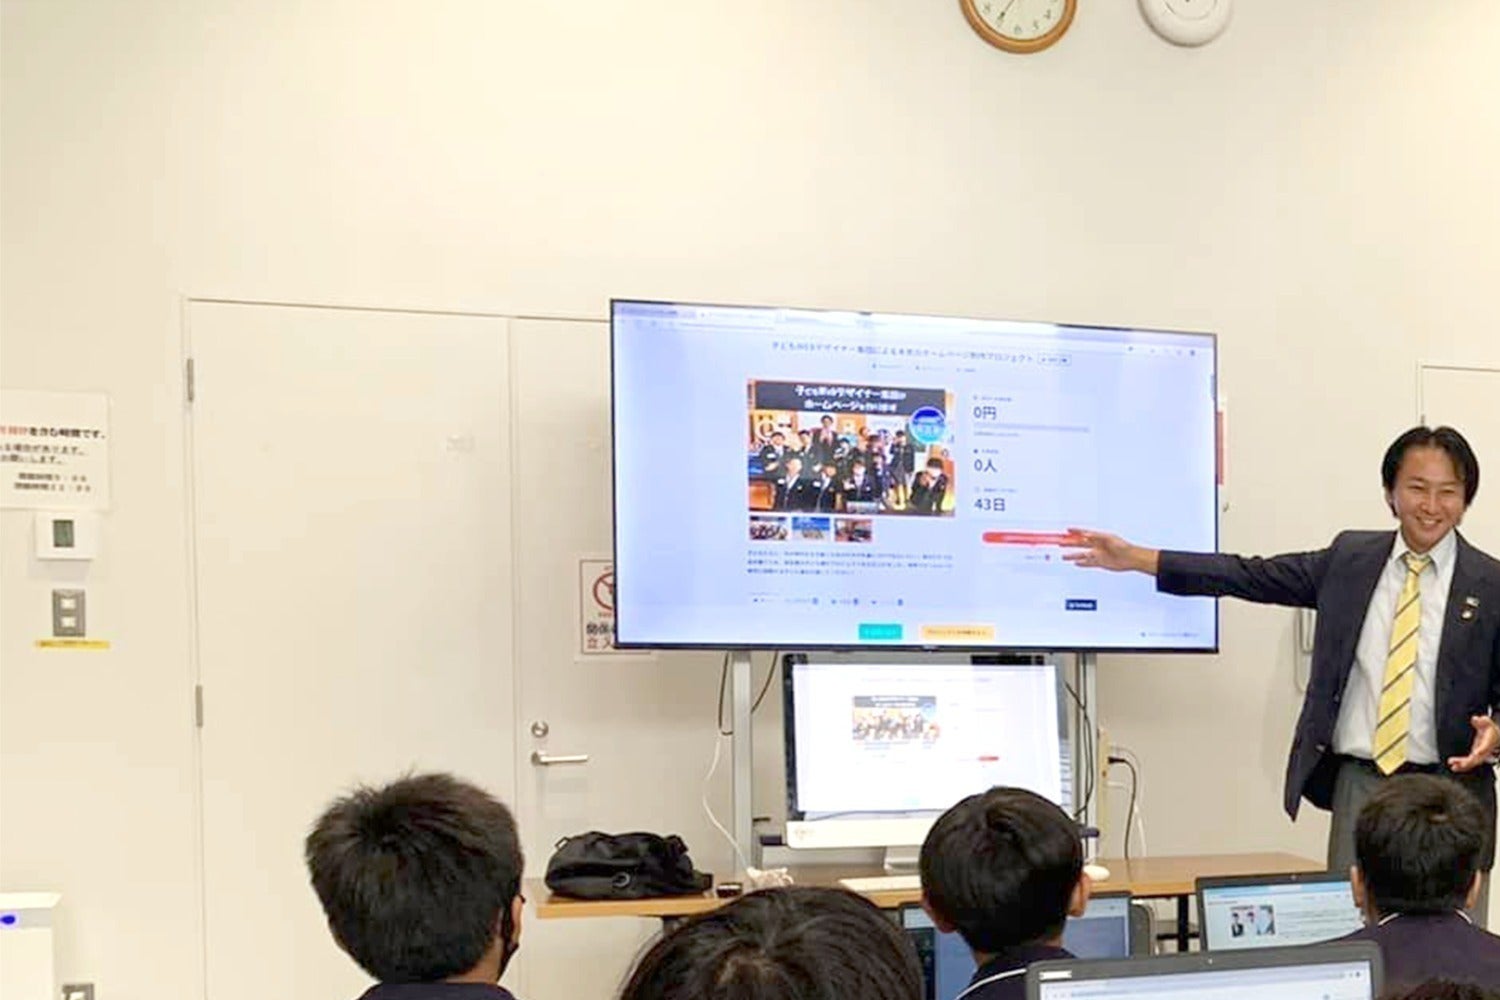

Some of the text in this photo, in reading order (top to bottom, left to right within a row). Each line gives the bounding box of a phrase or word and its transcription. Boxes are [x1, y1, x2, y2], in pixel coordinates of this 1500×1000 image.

[973, 406, 996, 420] 0円
[973, 458, 997, 472] 0人
[974, 497, 1006, 512] 43日
